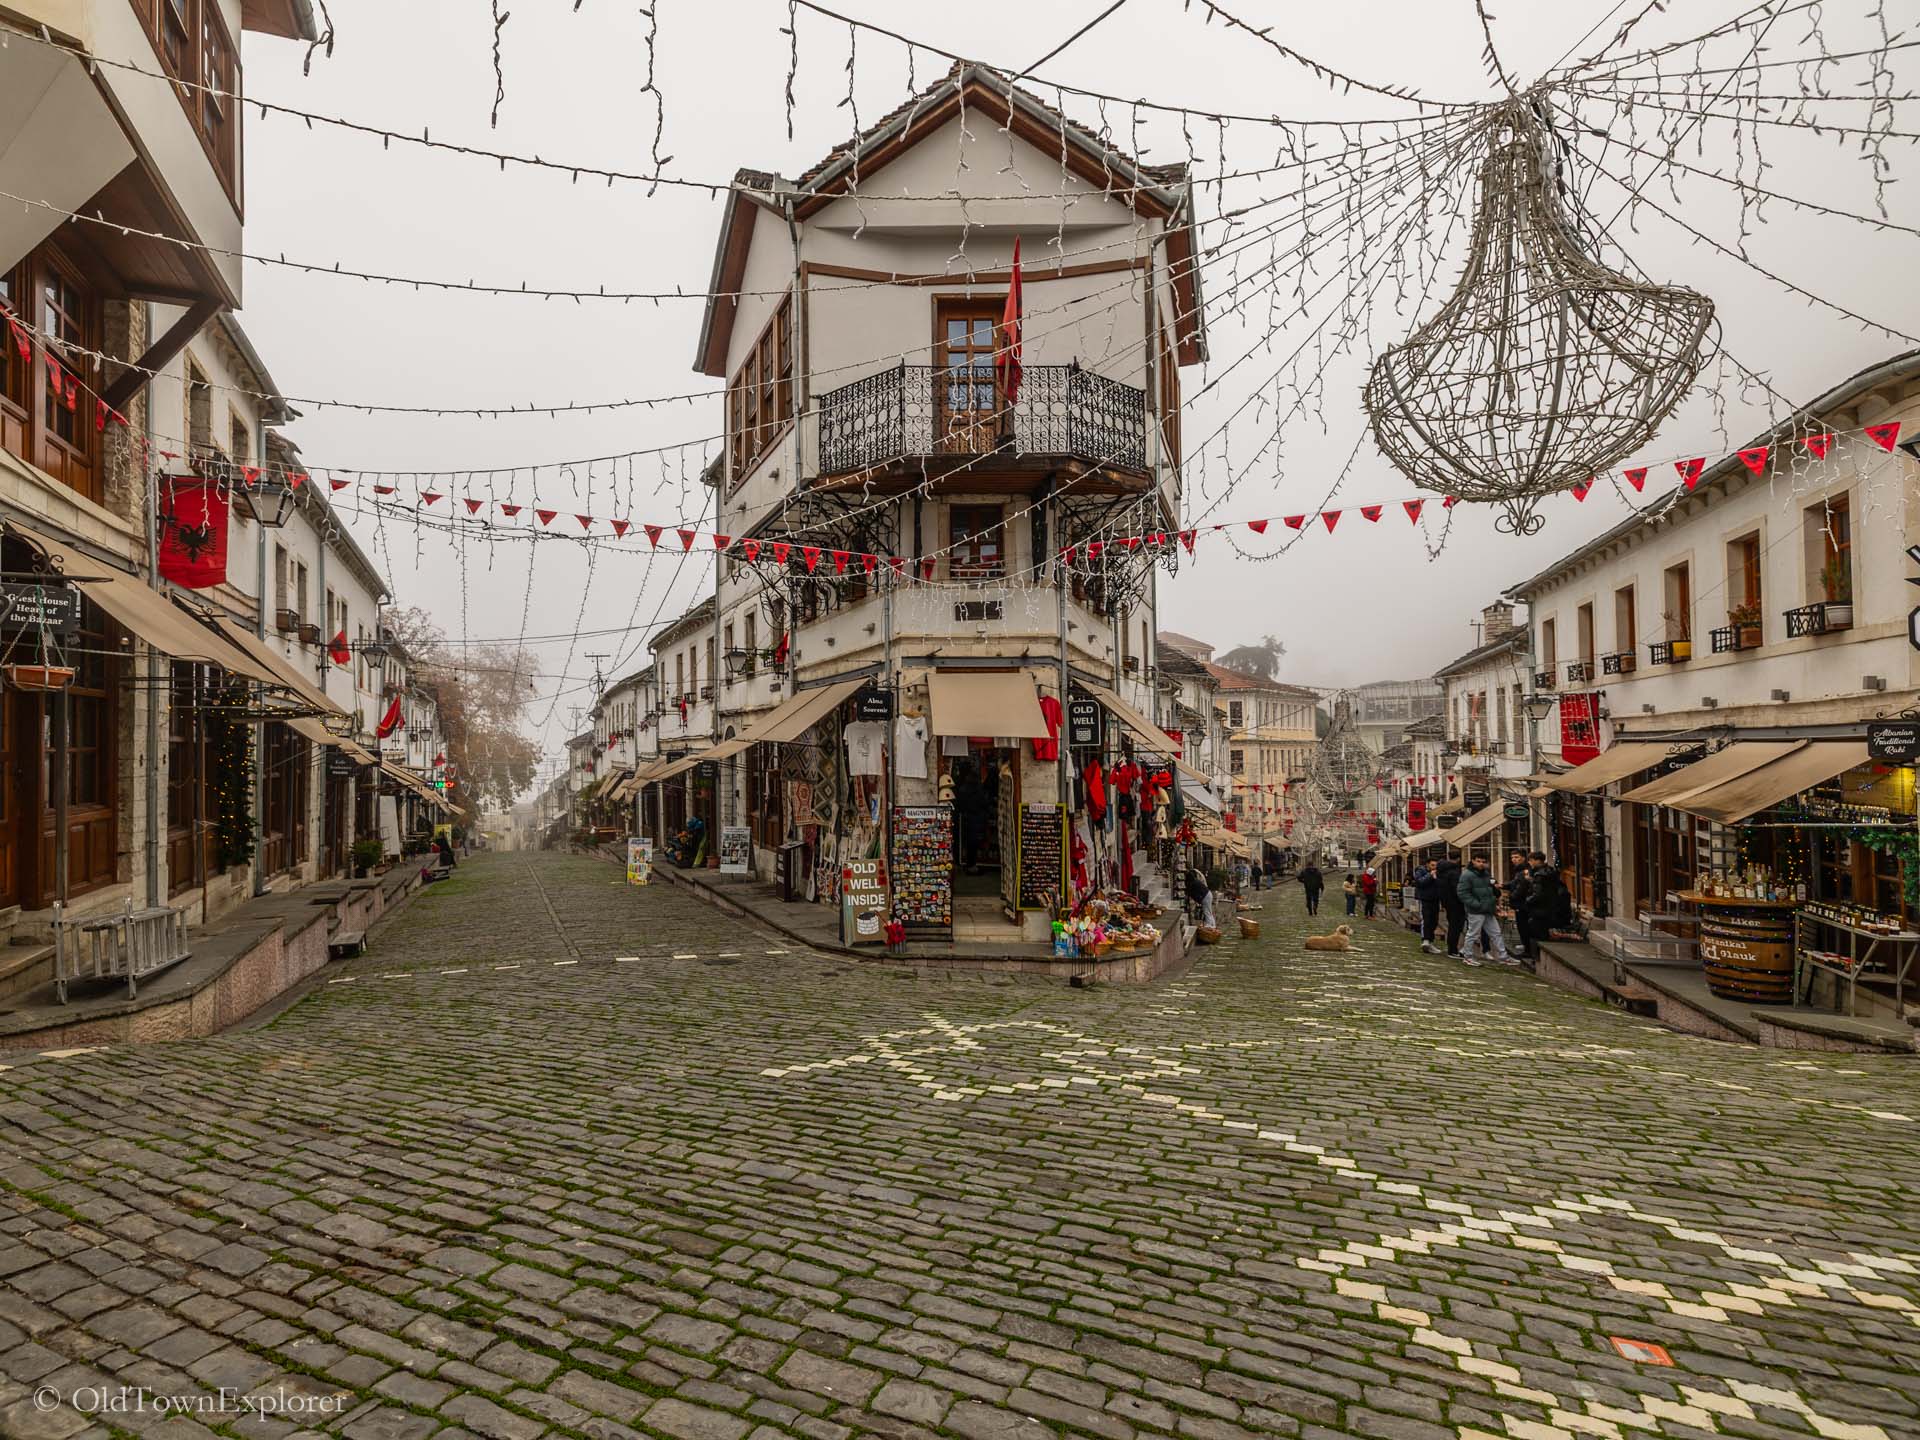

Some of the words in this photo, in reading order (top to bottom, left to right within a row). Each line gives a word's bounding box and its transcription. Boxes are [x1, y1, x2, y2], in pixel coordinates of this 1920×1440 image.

[46, 607, 57, 615] of
[10, 613, 26, 622] the
[863, 705, 888, 713] Souvenir
[1073, 706, 1094, 714] OLD
[1072, 716, 1095, 725] WELL
[1873, 728, 1914, 737] Albanian
[1873, 736, 1916, 746] Traditional
[1884, 745, 1906, 755] Raki
[907, 809, 935, 817] MAGNETS
[853, 862, 876, 874] OLD
[850, 878, 881, 890] WELL
[847, 893, 885, 906] INSIDE
[1731, 917, 1761, 927] Liker
